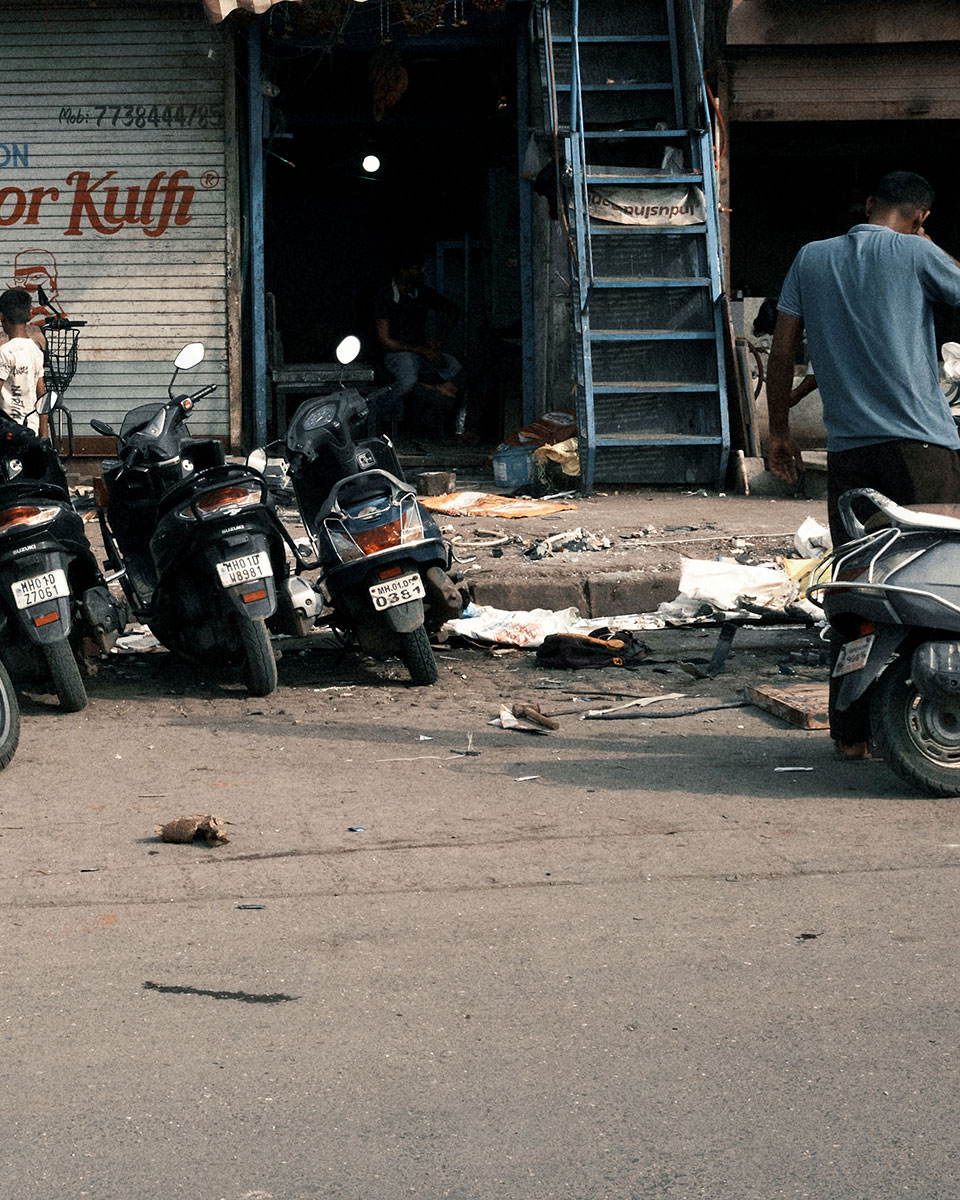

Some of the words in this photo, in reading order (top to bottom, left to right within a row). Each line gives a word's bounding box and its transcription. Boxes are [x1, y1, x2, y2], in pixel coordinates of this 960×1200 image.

[58, 107, 89, 125] Mob:
[64, 170, 195, 238] Kulfi
[221, 524, 245, 534] SUZUKI
[12, 544, 37, 555] SUZUKI
[24, 585, 59, 605] Z7061
